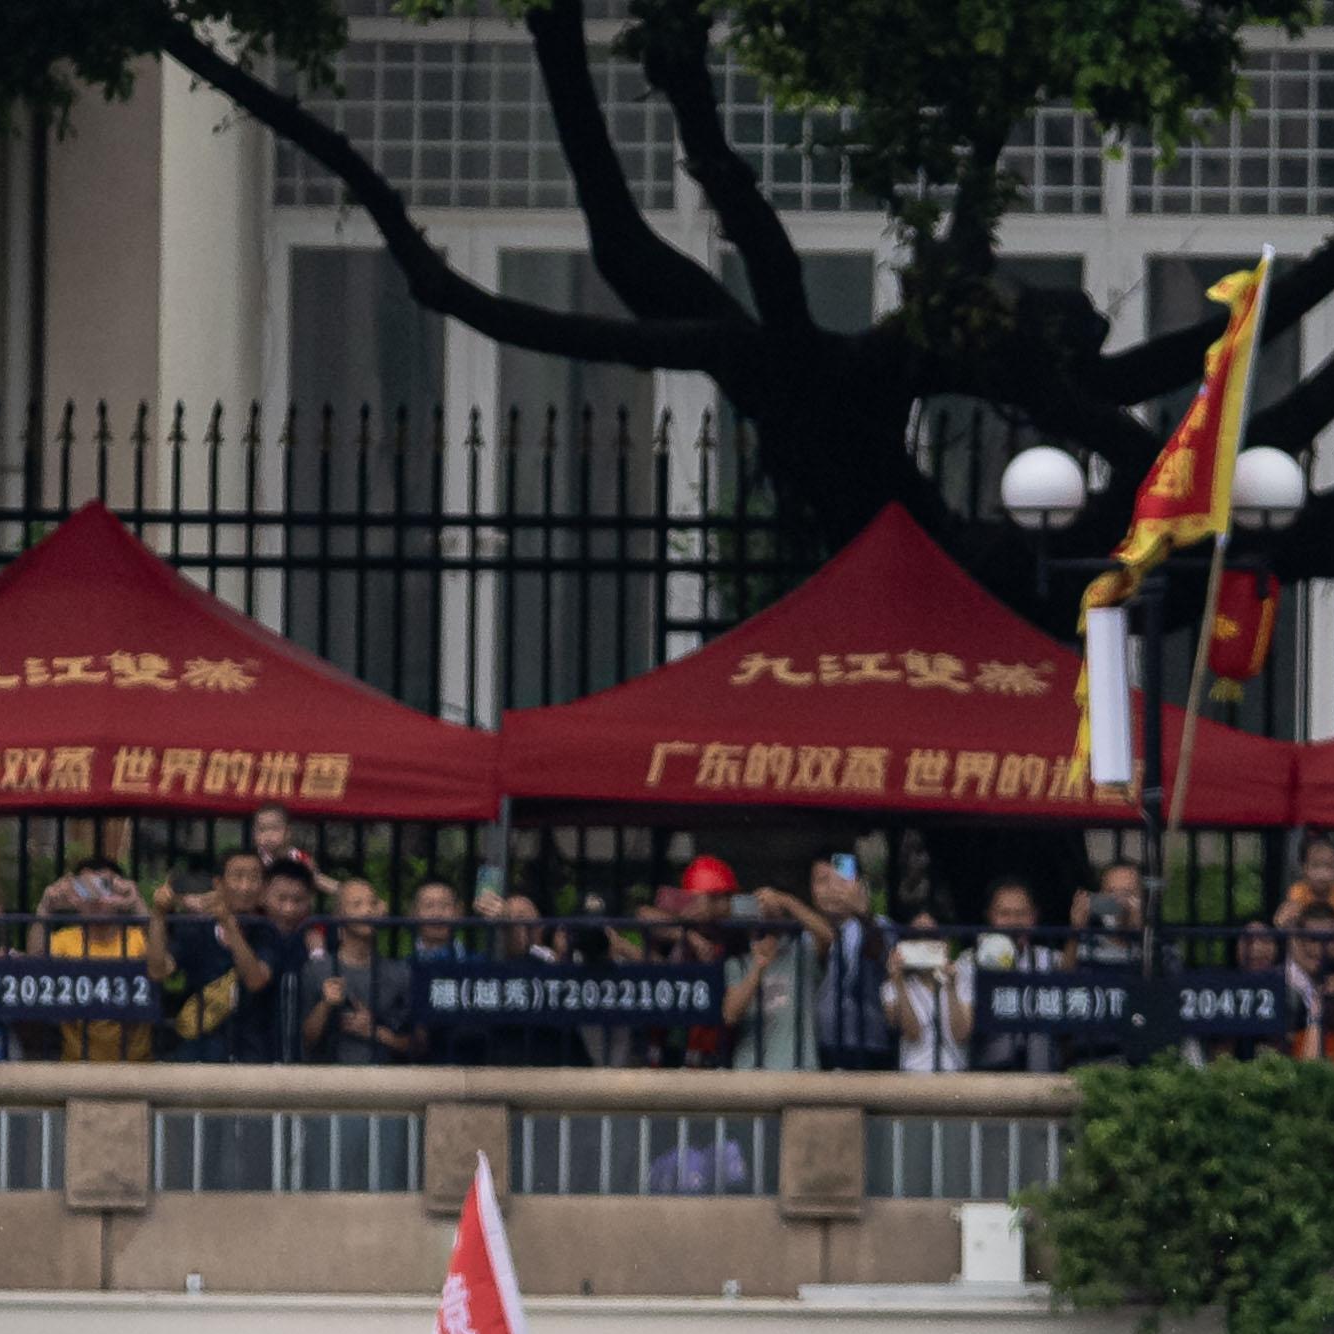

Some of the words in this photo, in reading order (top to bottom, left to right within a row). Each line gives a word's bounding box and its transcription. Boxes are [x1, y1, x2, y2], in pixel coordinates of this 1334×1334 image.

[111, 746, 351, 800] 世界的米香
[646, 741, 889, 793] 广东的双蒸
[991, 985, 1276, 1020] 穗(越秀)T20472
